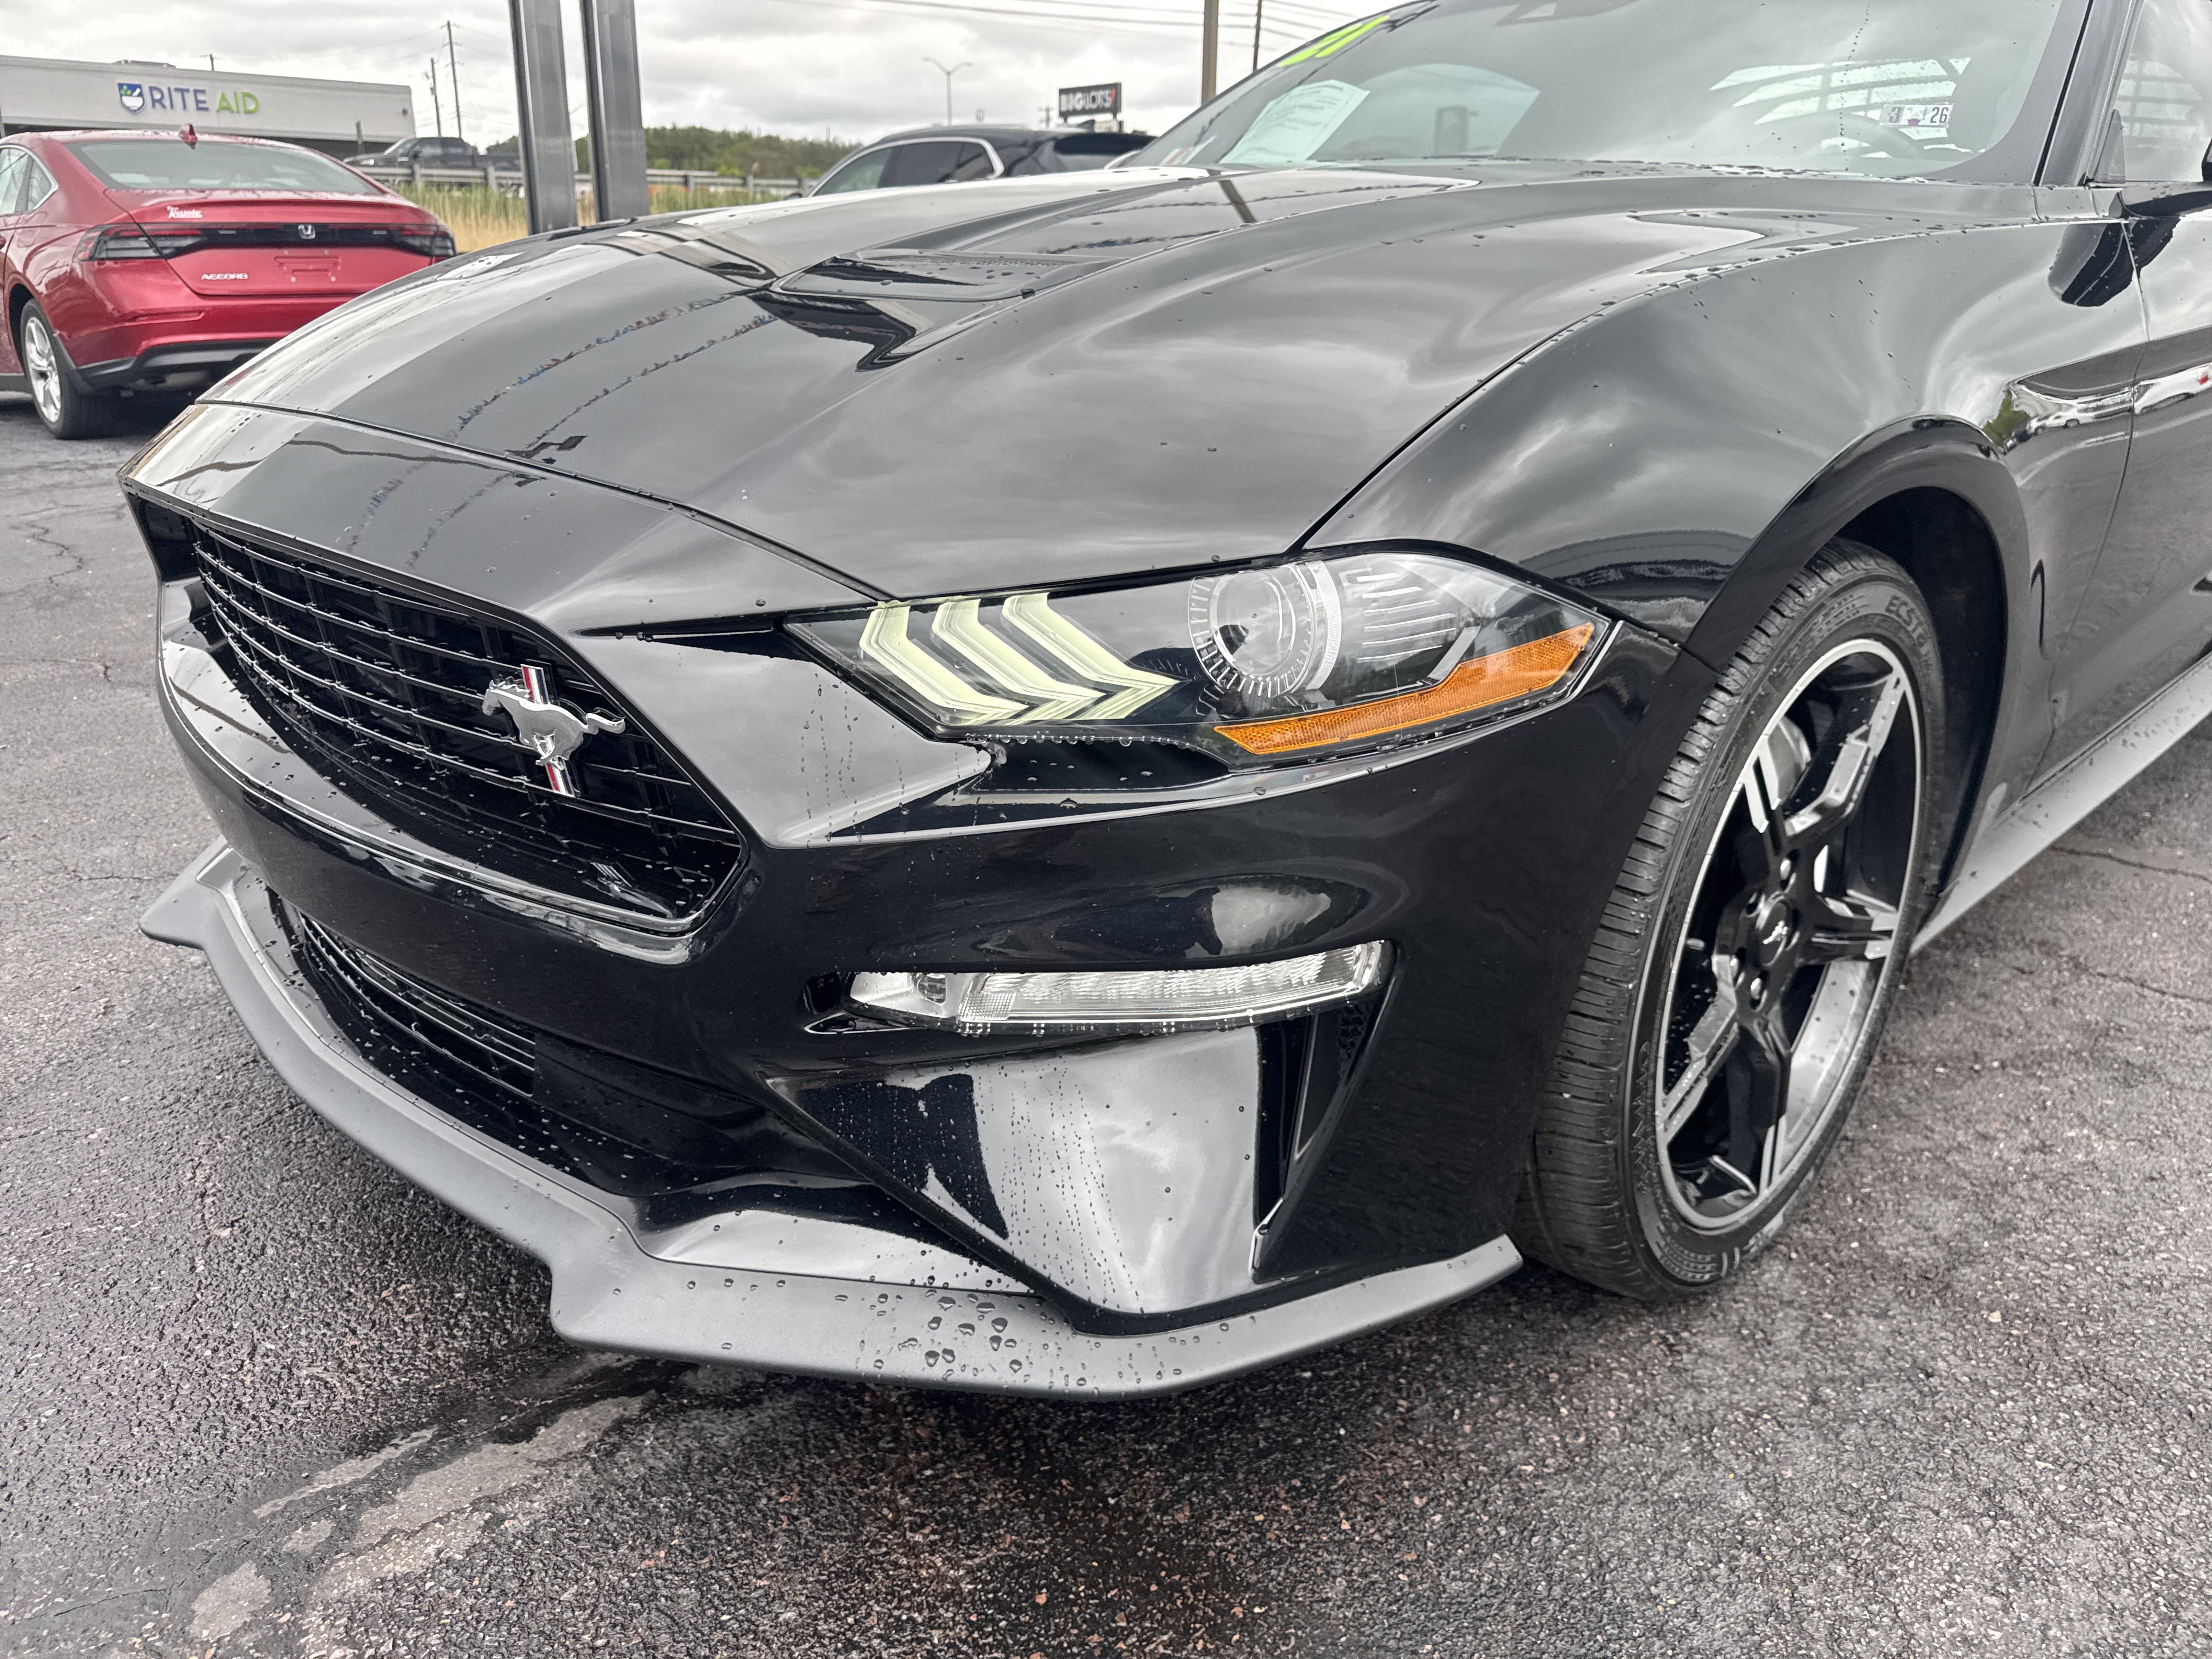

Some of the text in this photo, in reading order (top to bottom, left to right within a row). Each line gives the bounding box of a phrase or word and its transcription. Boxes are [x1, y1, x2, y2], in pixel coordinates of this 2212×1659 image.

[149, 86, 259, 114] RITE AID
[1930, 106, 1949, 123] 26
